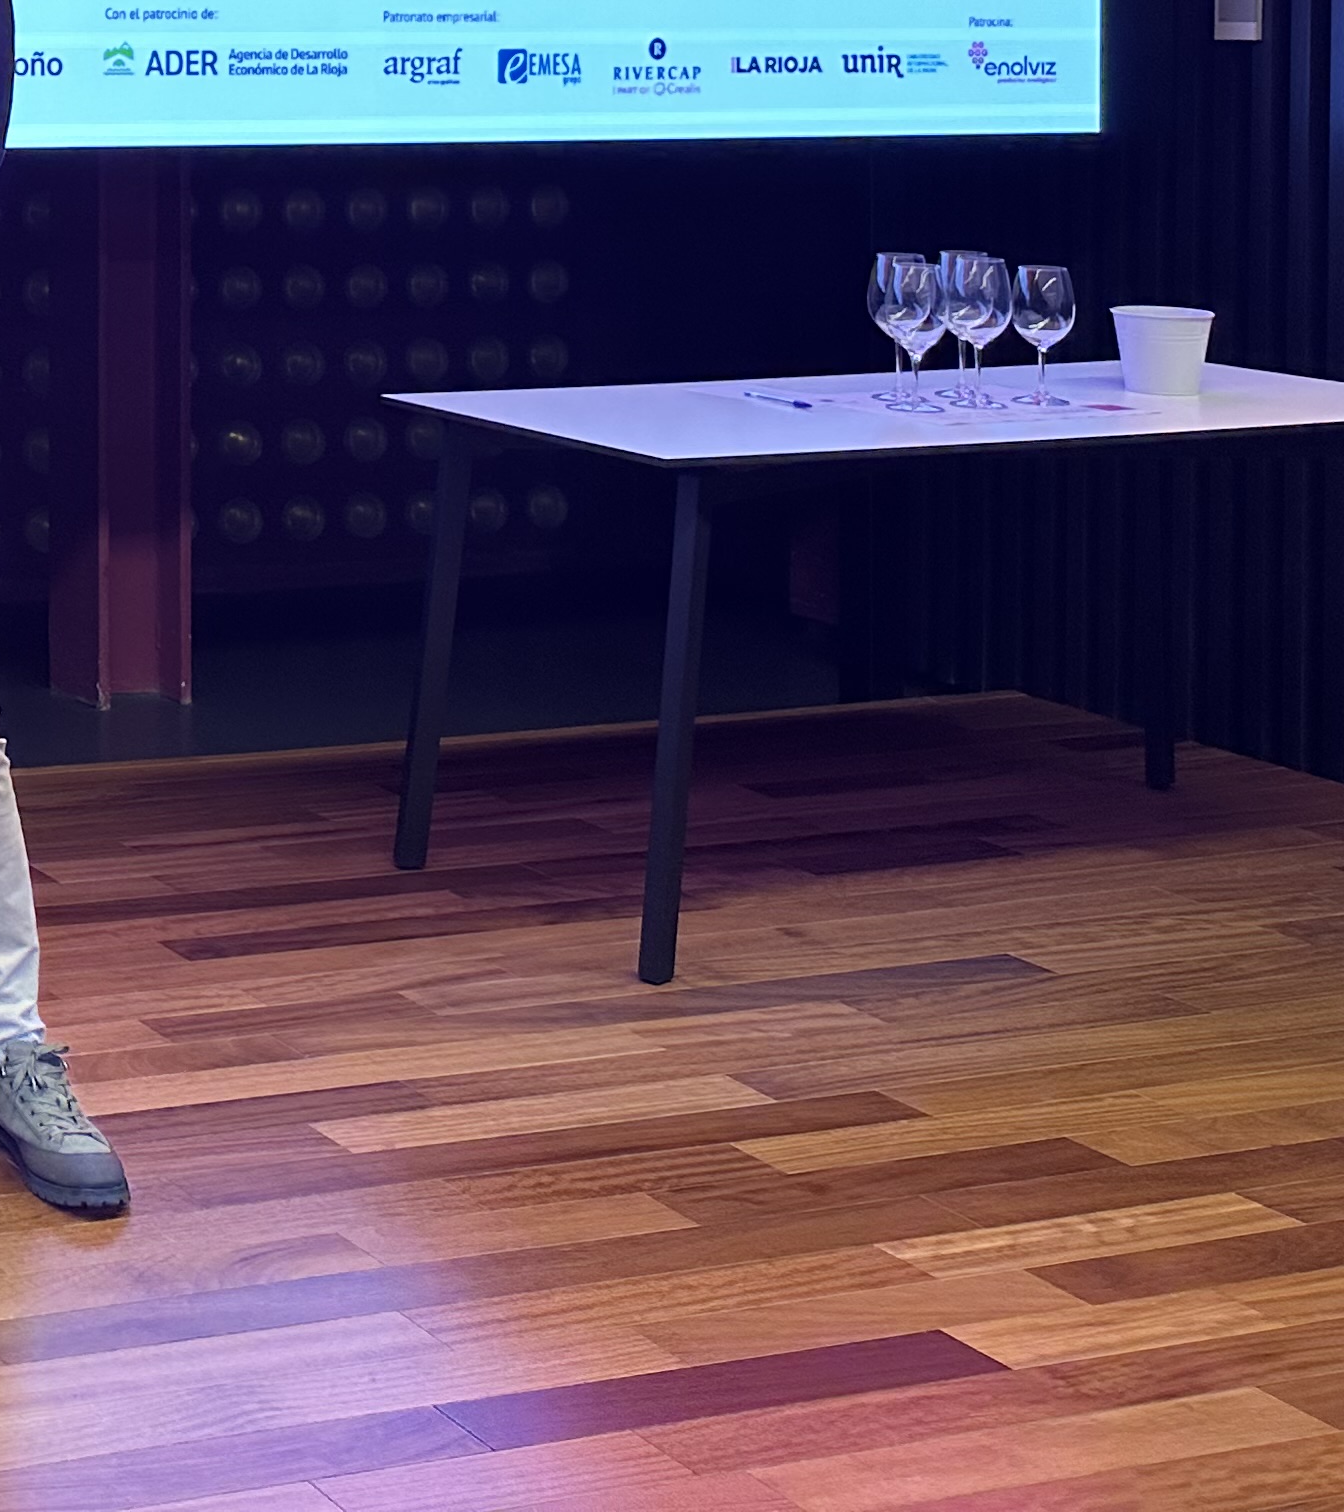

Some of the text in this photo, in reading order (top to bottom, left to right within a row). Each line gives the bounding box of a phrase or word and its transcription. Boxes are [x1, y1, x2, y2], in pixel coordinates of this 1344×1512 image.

[105, 7, 126, 20] Con
[129, 8, 140, 20] el
[143, 8, 198, 22] patrocinio
[383, 10, 433, 22] Patronato
[145, 50, 218, 76] ADER
[229, 48, 348, 63] Agencia de Desarrollo
[229, 63, 288, 75] Económico
[290, 64, 304, 75] de
[383, 47, 463, 83] argraf
[529, 53, 581, 76] EMESA
[736, 56, 823, 73] LA RIOJA
[613, 66, 701, 80] RIVERCAP
